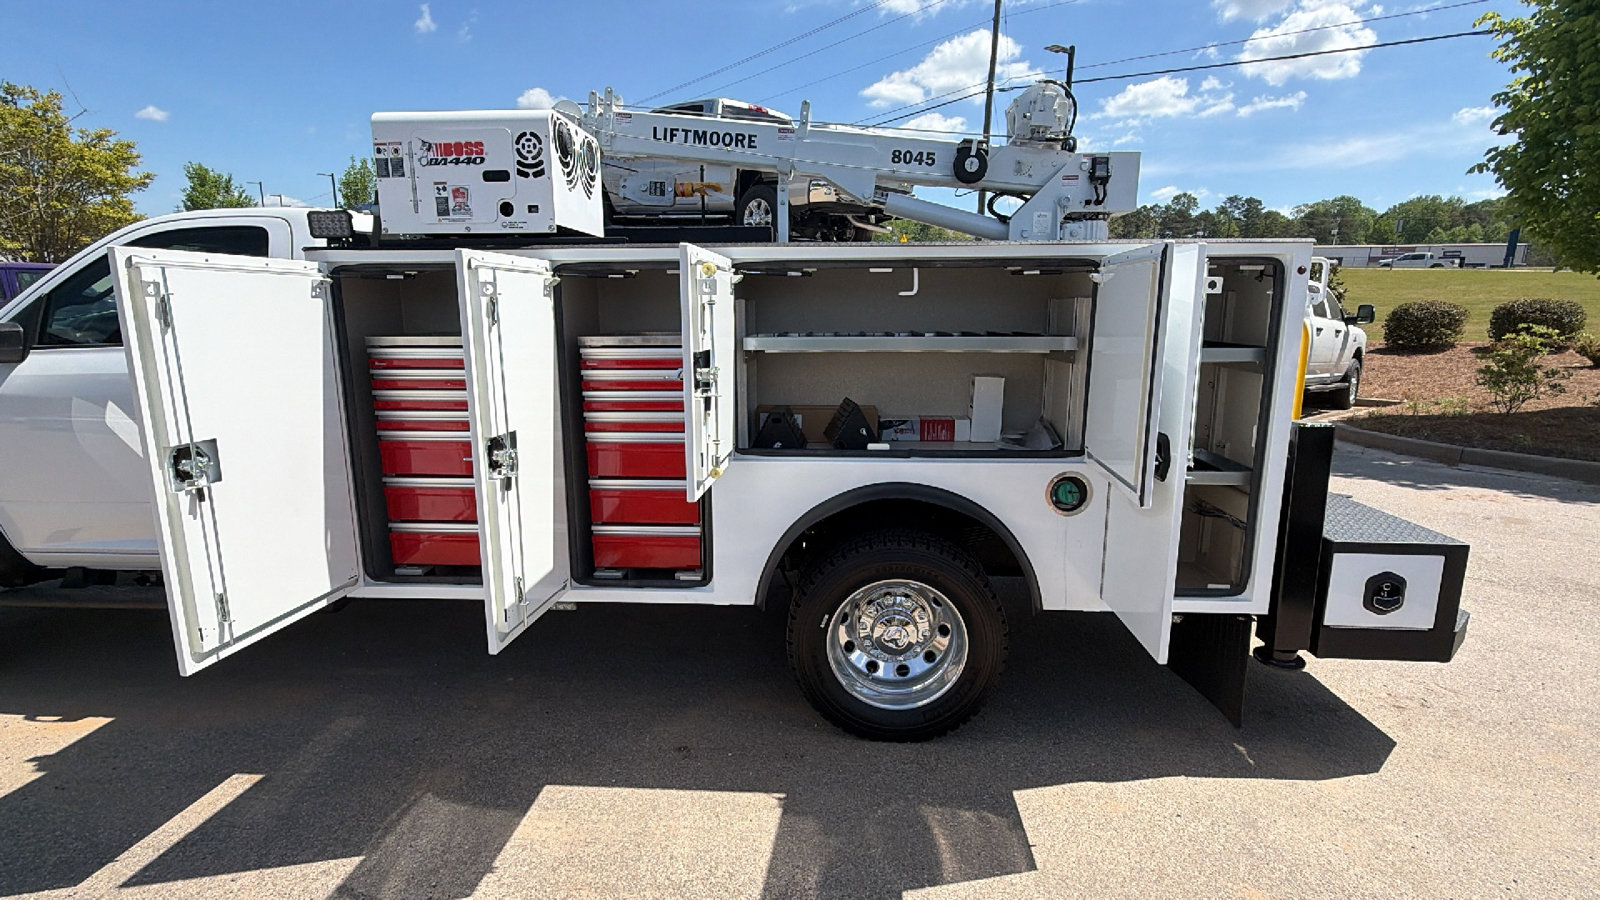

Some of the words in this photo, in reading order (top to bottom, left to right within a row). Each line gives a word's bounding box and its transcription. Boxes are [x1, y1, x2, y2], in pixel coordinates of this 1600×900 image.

[652, 126, 758, 149] LIFTMOORE
[442, 141, 484, 157] BOSS
[891, 149, 936, 167] 8045
